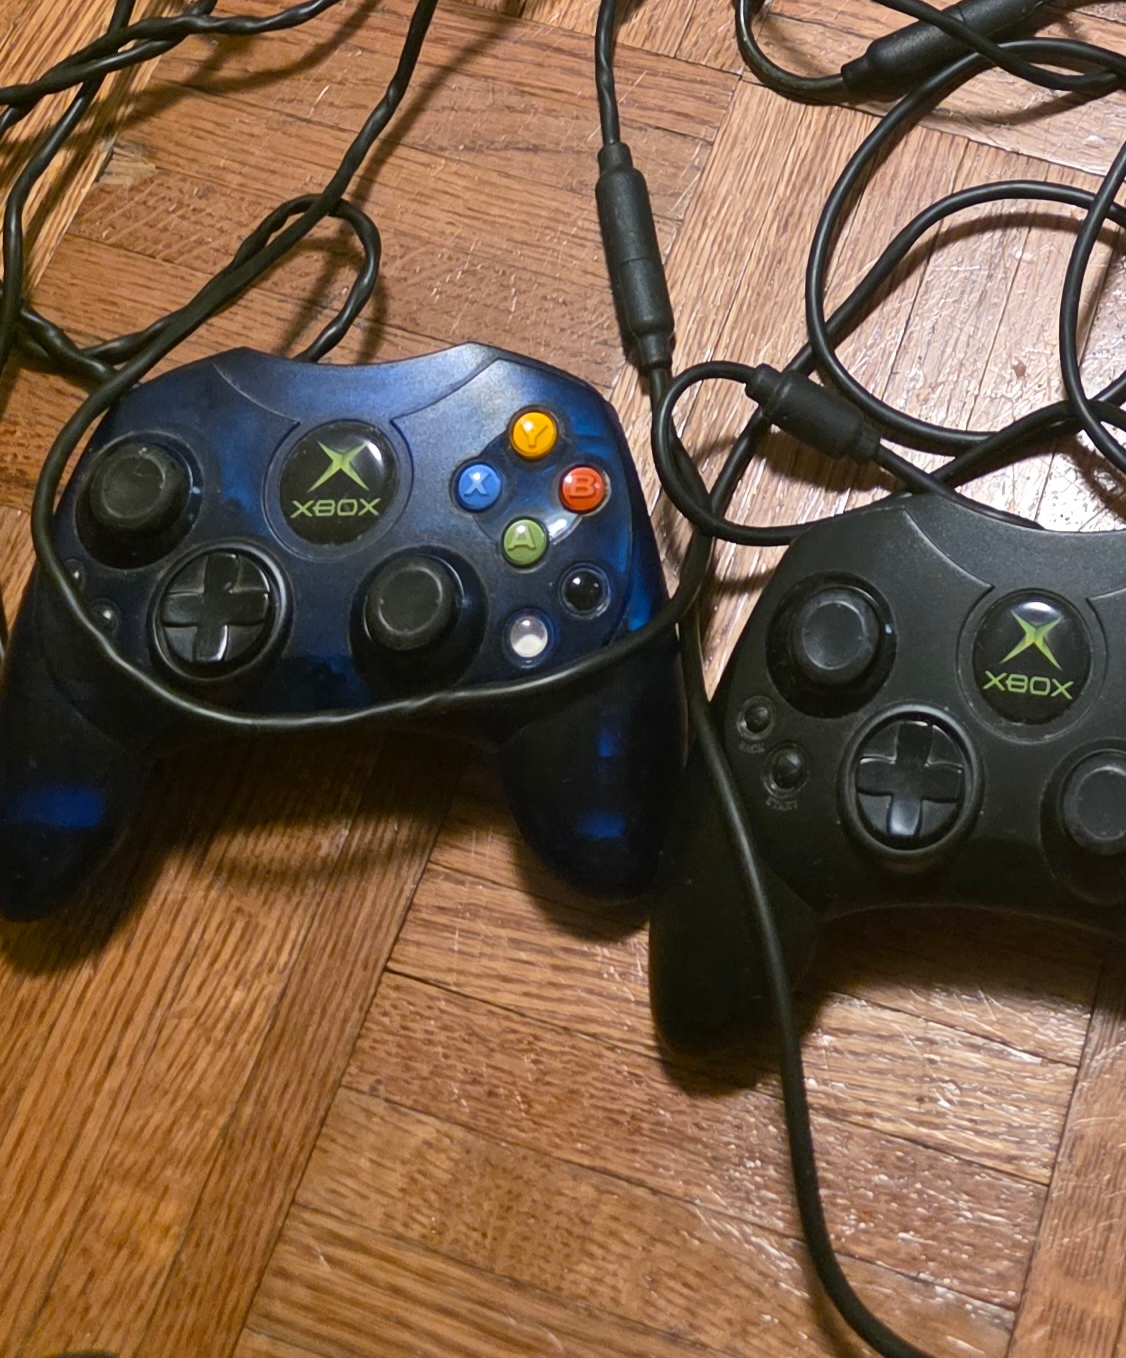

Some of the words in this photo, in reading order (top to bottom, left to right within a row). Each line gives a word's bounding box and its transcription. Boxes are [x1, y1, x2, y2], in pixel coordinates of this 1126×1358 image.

[519, 423, 549, 449] Y
[463, 473, 492, 498] X
[568, 476, 598, 500] B
[290, 497, 382, 518] XBOX
[507, 523, 537, 551] A
[983, 670, 1075, 700] XBOX
